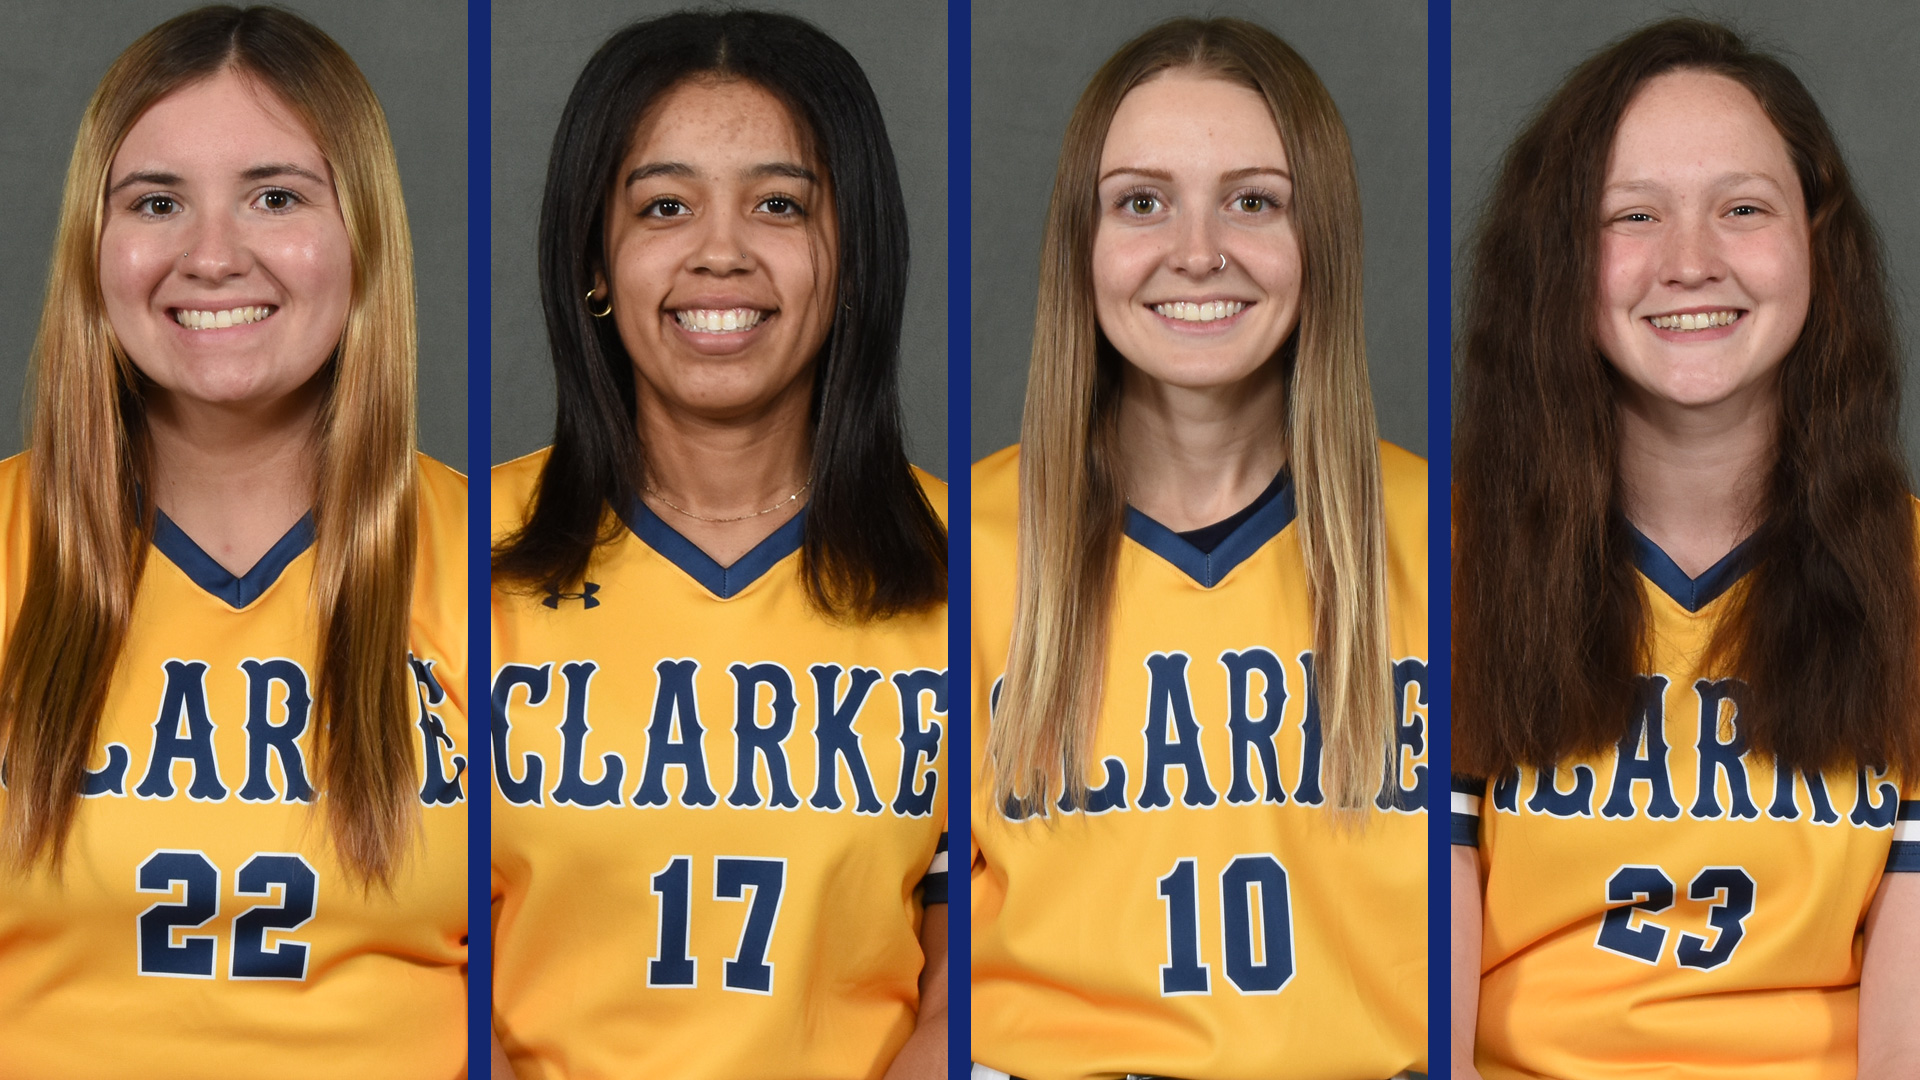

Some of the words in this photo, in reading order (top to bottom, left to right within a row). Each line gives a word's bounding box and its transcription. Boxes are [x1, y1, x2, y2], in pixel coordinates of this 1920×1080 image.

[491, 657, 948, 818] CLARKE
[135, 848, 319, 981] 22
[646, 854, 788, 996] 17
[1156, 852, 1297, 997] 10
[1593, 863, 1757, 973] 23
